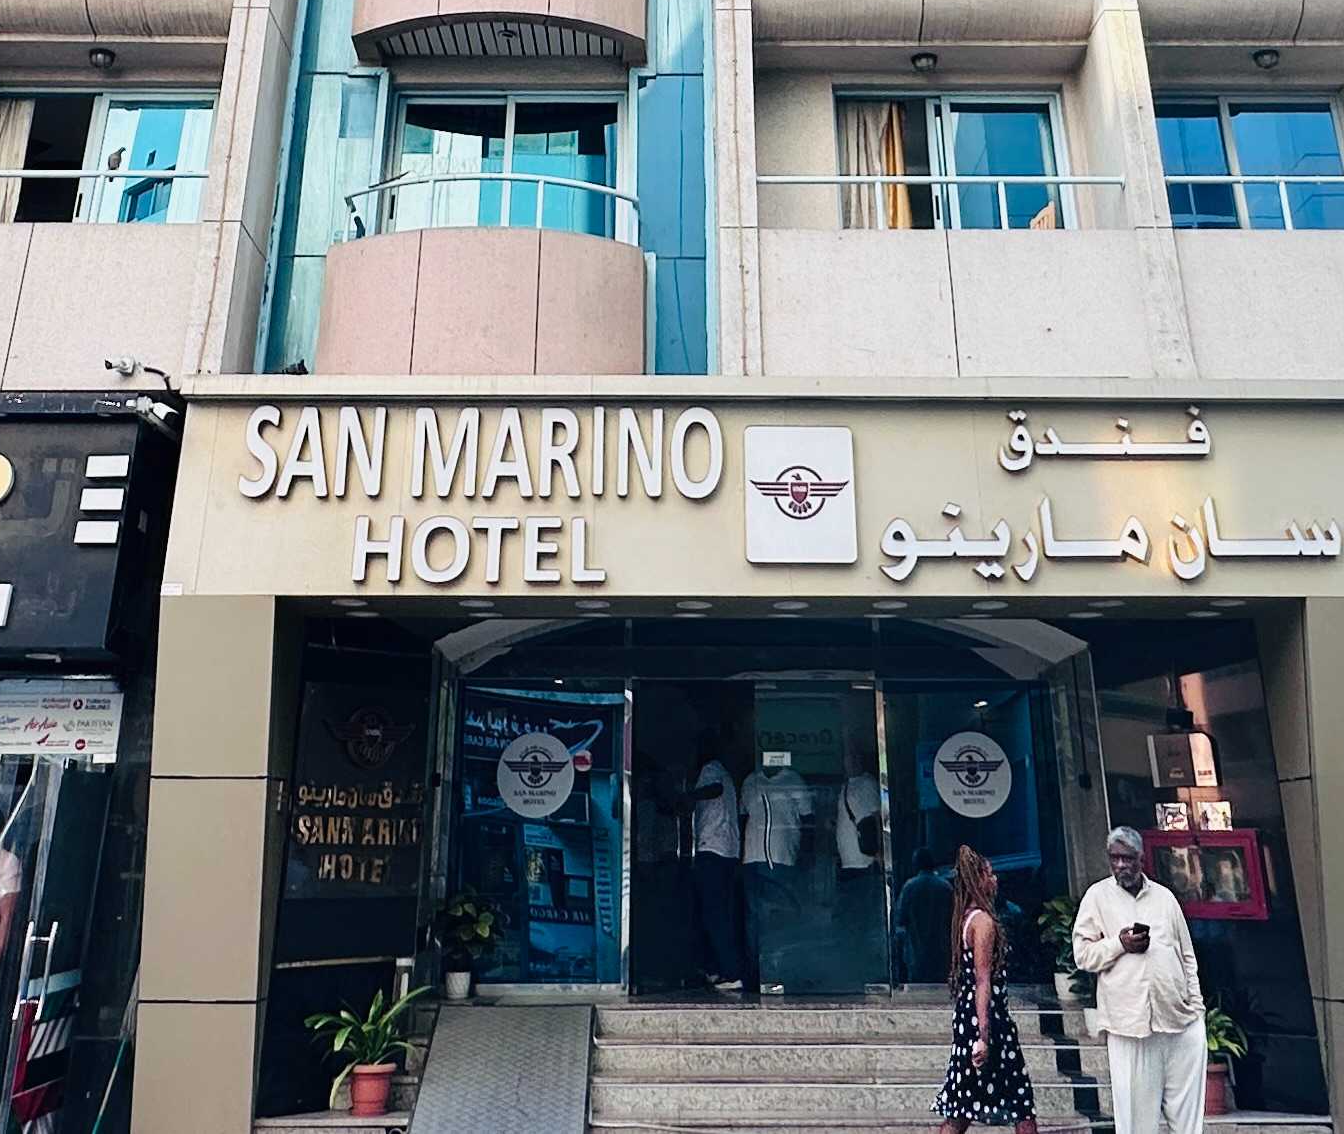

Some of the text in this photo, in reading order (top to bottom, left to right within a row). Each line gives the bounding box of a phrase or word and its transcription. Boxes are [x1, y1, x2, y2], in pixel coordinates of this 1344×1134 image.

[238, 405, 724, 500] SAN MARINO
[997, 404, 1213, 473] فندق
[351, 516, 607, 584] HOTEL
[879, 495, 1344, 583] سان مارينو
[297, 815, 340, 846] SAN
